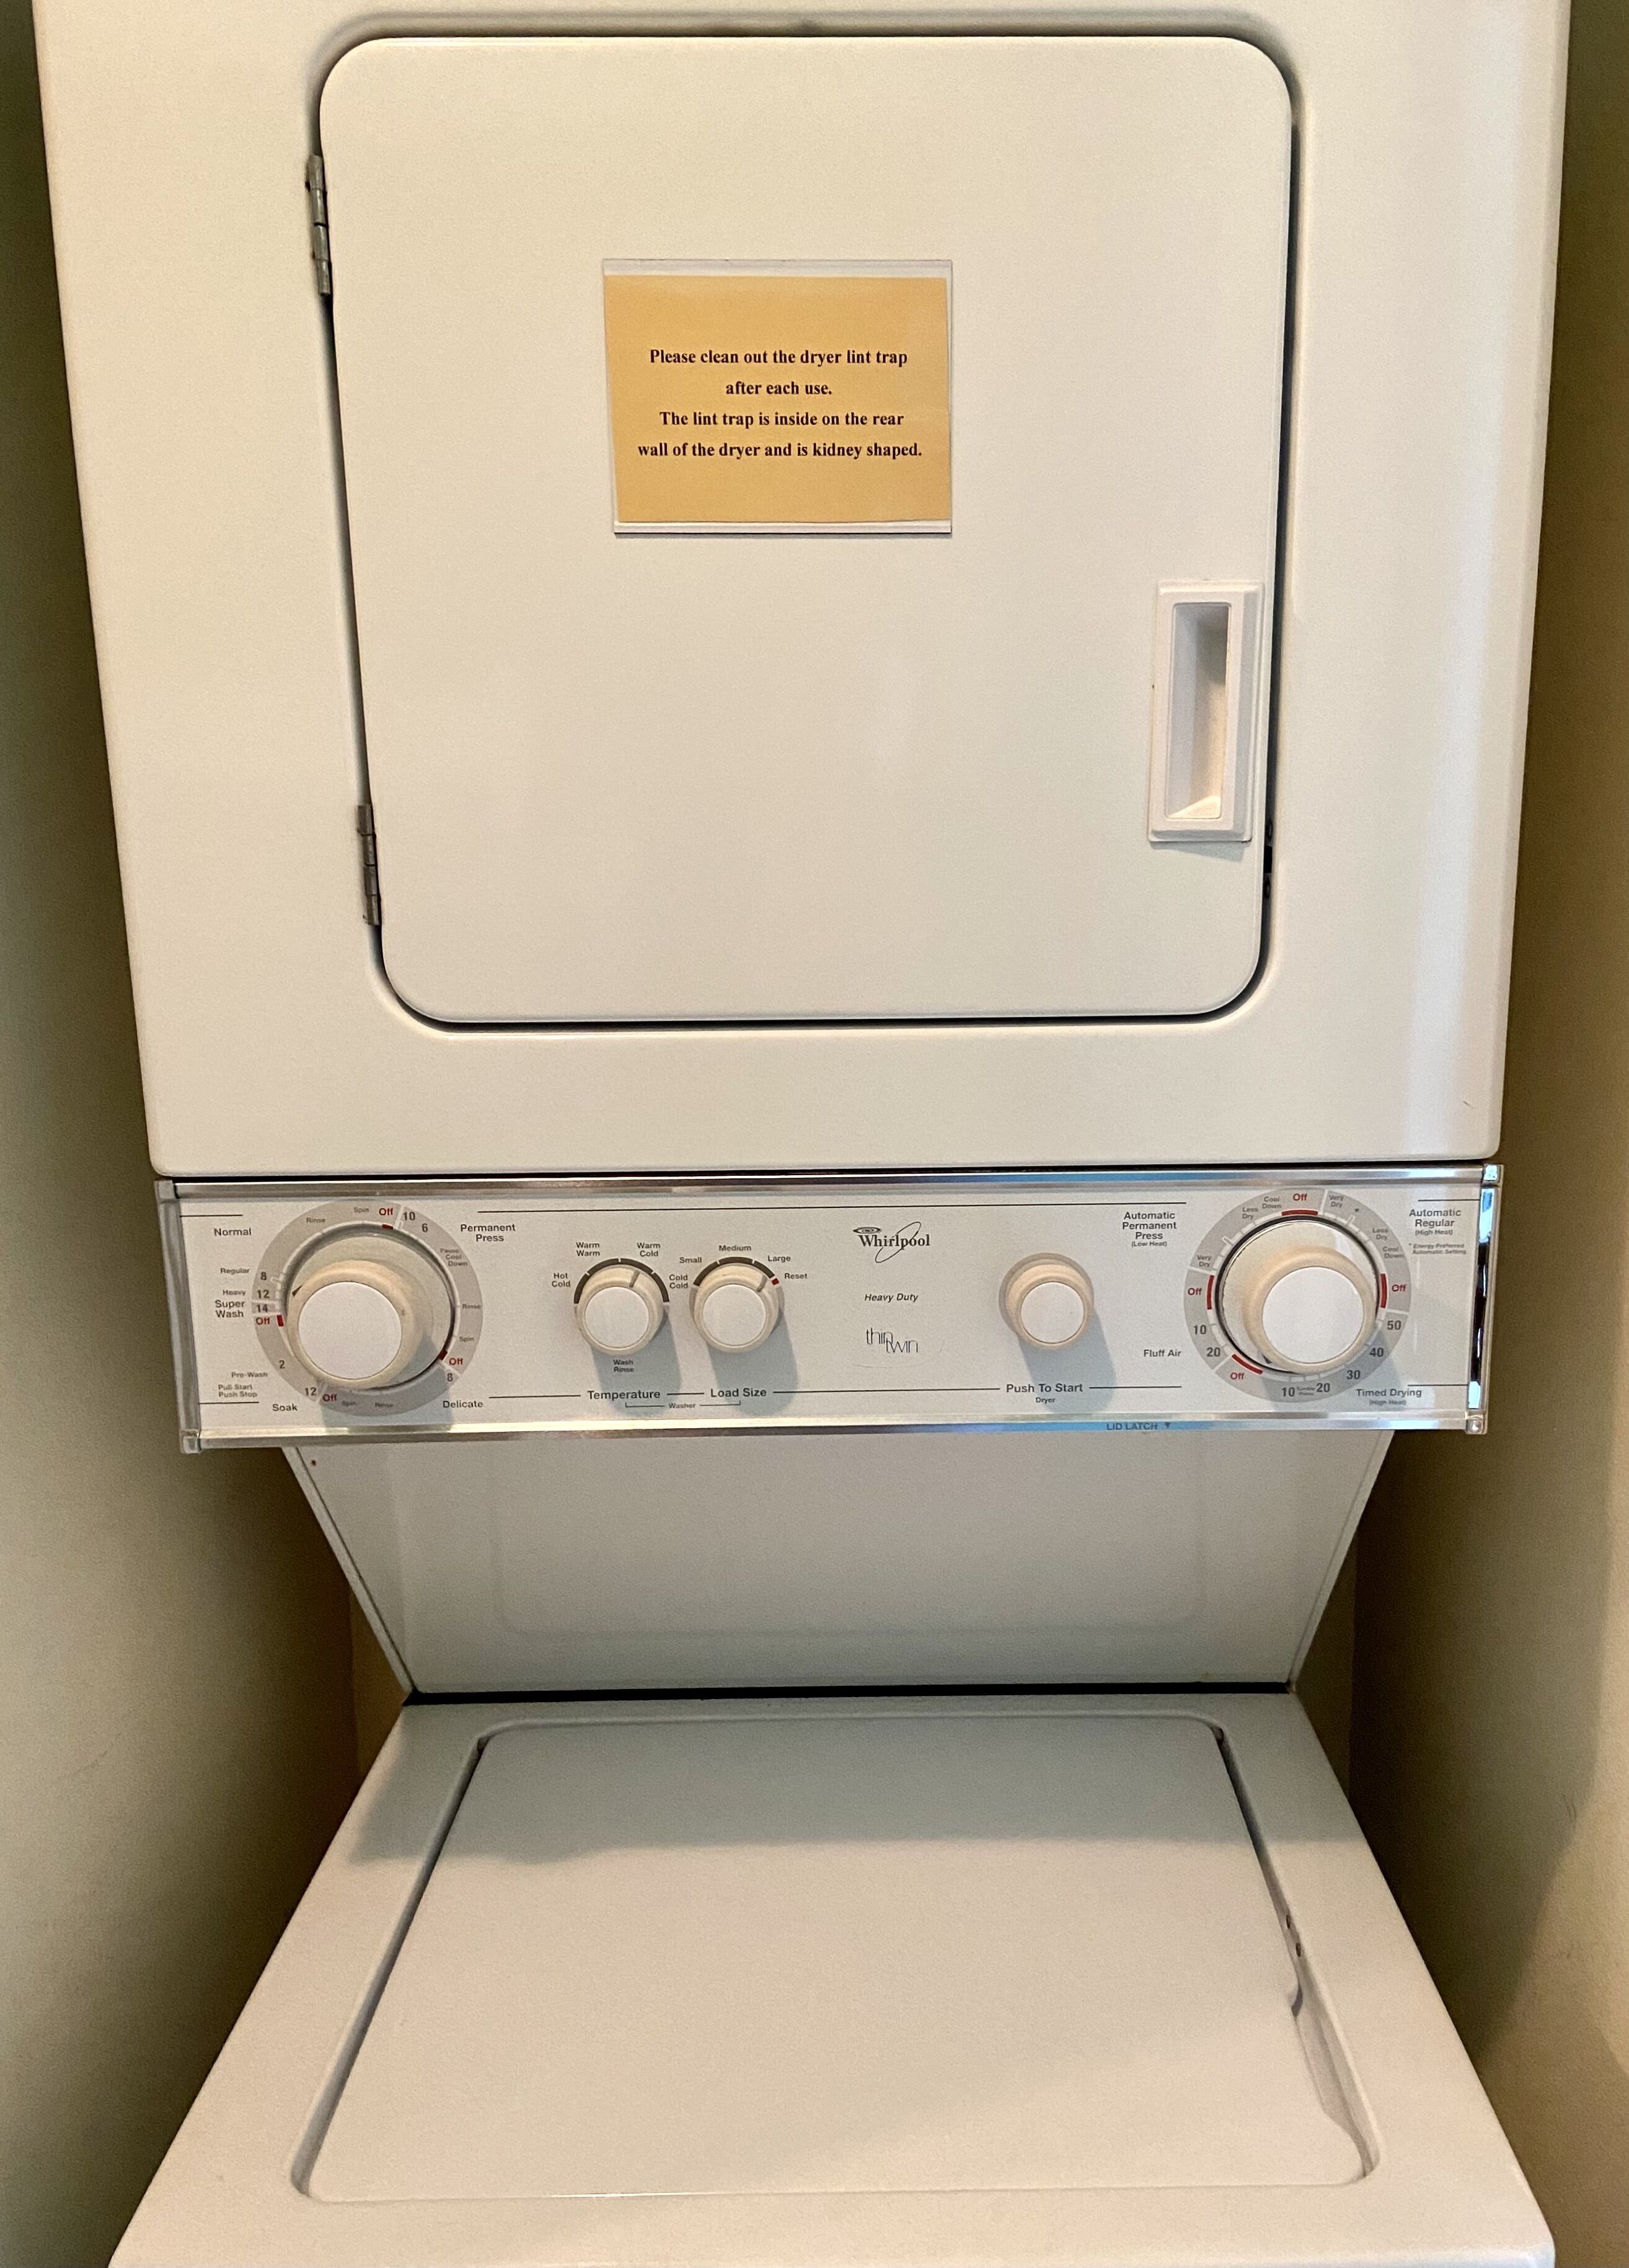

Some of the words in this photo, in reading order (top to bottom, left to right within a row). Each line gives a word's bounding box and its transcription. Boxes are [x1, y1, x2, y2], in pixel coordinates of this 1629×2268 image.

[650, 349, 696, 364] Please
[700, 349, 739, 364] clean
[744, 352, 768, 364] out
[772, 350, 795, 364] the
[800, 350, 842, 367] dryer
[846, 350, 871, 364] lint
[875, 352, 907, 367] trap
[725, 381, 762, 395] after
[766, 381, 799, 395] each
[805, 384, 832, 395] use.
[660, 412, 688, 425] The
[693, 412, 718, 425] lint
[722, 414, 754, 428] trap
[759, 412, 770, 425] is
[774, 412, 818, 425] inside
[822, 415, 840, 425] on
[845, 412, 868, 425] the
[873, 415, 904, 425] rear
[638, 443, 668, 456] wall
[673, 443, 688, 456] of
[692, 443, 715, 456] the
[718, 443, 761, 459] dryer
[764, 443, 792, 456] and
[797, 443, 808, 456] is
[813, 443, 862, 459] kidney
[866, 443, 922, 459] shaped.
[1293, 1193, 1307, 1202] Off
[379, 1207, 394, 1216] Off
[1124, 1211, 1175, 1220] Automatic
[1409, 1209, 1462, 1217] Automatic
[403, 1212, 415, 1221] 10
[461, 1224, 516, 1232] Permanent
[1122, 1222, 1177, 1230] Permanent
[1415, 1219, 1454, 1228] Regular
[214, 1228, 252, 1237] Normal
[422, 1224, 428, 1233] 6
[475, 1233, 505, 1242] Press
[1135, 1232, 1163, 1240] Press
[858, 1234, 930, 1250] Whirlpool
[767, 1255, 791, 1263] Large
[260, 1271, 267, 1281] 8
[1188, 1287, 1202, 1296] Off
[1392, 1284, 1406, 1292] Off
[257, 1290, 270, 1299] 12
[865, 1294, 893, 1302] Heavy
[896, 1294, 919, 1302] Duty
[215, 1300, 245, 1309] Super
[256, 1304, 268, 1313] 14
[215, 1310, 244, 1318] Wash
[256, 1317, 270, 1325] Off
[1387, 1321, 1402, 1330] 50
[1193, 1325, 1207, 1335] 10
[1206, 1348, 1221, 1357] 20
[1370, 1348, 1384, 1357] 40
[279, 1360, 285, 1369] 2
[449, 1357, 464, 1366] Off
[447, 1373, 453, 1382] 8
[1230, 1372, 1244, 1380] Off
[1346, 1370, 1361, 1380] 30
[304, 1387, 317, 1397] 12
[710, 1388, 739, 1397] Load
[743, 1388, 767, 1397] Size
[1006, 1383, 1035, 1393] Push
[1038, 1383, 1051, 1393] To
[1055, 1383, 1083, 1393] Start
[1282, 1388, 1295, 1397] 10
[1317, 1383, 1330, 1393] 20
[322, 1393, 337, 1401] Off
[588, 1390, 660, 1401] Temperature
[1356, 1388, 1387, 1397] Timed
[1389, 1388, 1422, 1398] Drying
[443, 1400, 483, 1408] Delicate
